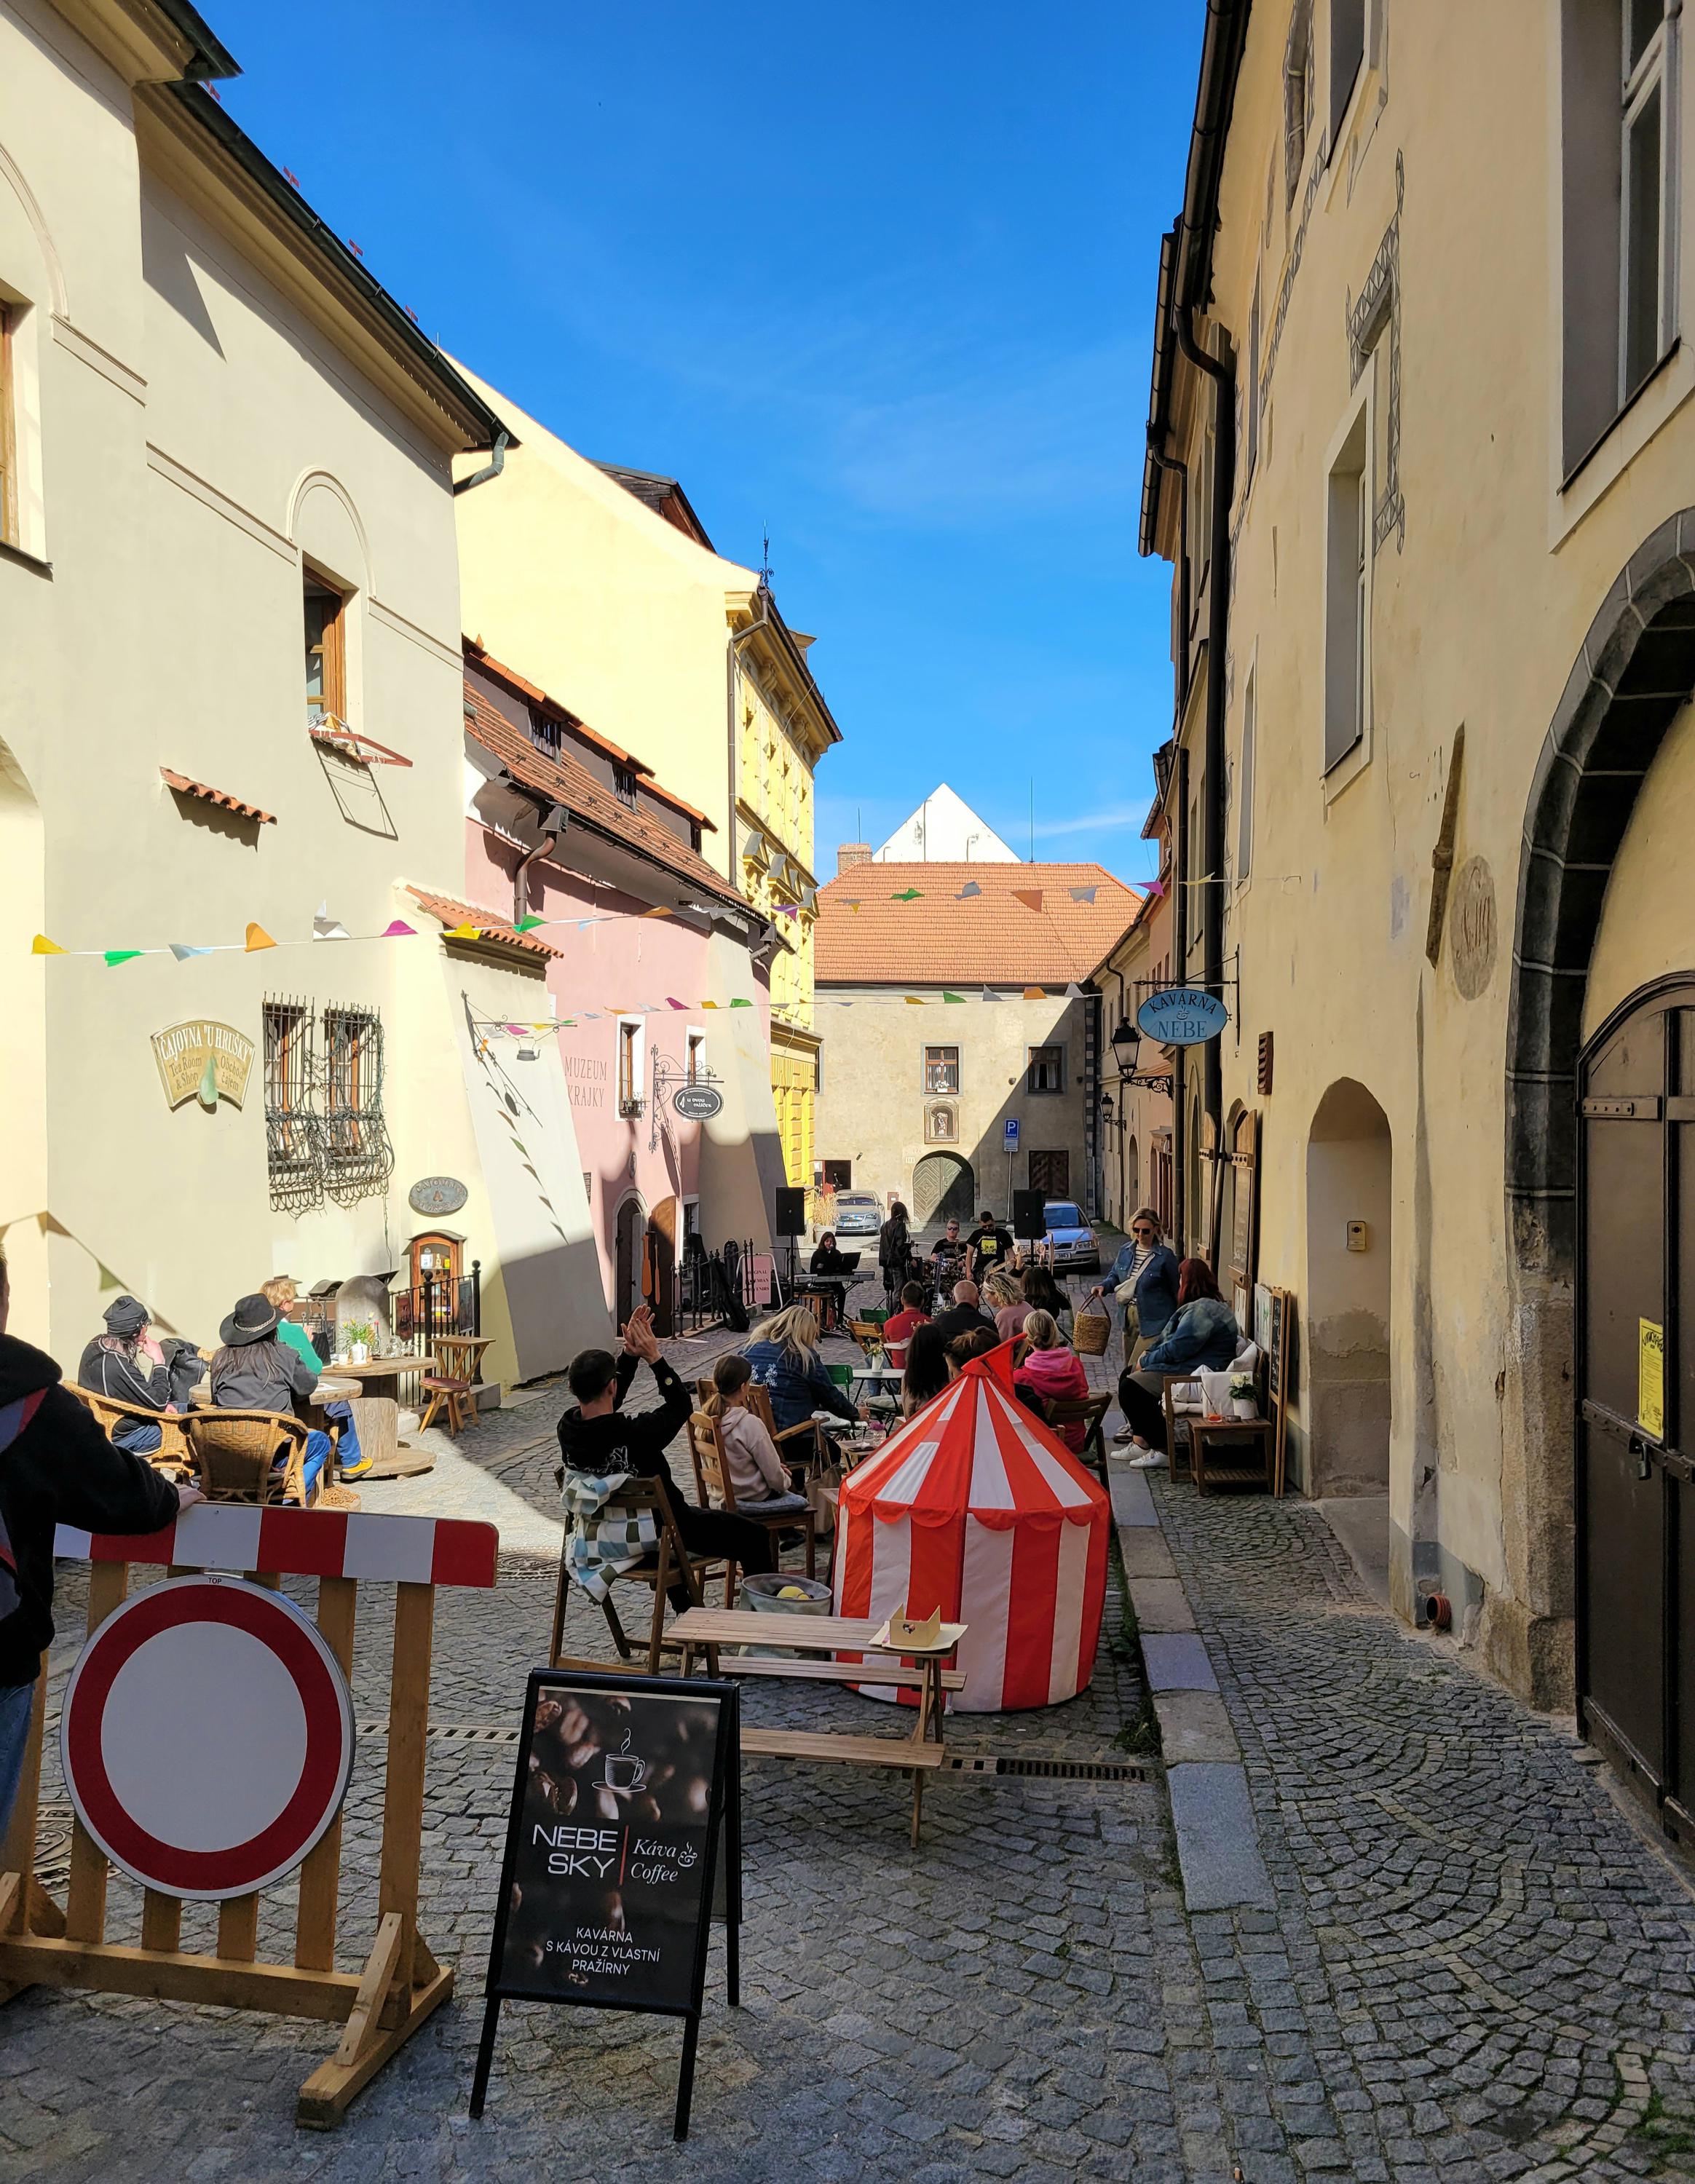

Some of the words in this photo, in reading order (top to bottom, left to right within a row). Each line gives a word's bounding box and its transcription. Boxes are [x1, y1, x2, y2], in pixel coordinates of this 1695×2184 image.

[1149, 991, 1217, 1015] KAVÁRNA
[1158, 1021, 1207, 1037] NEBE
[160, 1025, 202, 1061] ČAJOVNA
[215, 1027, 253, 1062] HRUŠKY"
[169, 1063, 182, 1077] Tea
[182, 1056, 202, 1071] Room
[221, 1055, 246, 1080] Obchod
[565, 1056, 607, 1080] MUZEUM
[175, 1077, 182, 1091] &
[181, 1072, 199, 1087] Shop
[221, 1072, 239, 1091] čajem
[568, 1085, 604, 1107] KRAJKY
[1008, 1122, 1016, 1133] P
[532, 1824, 618, 1852] NEBE
[633, 1838, 676, 1858] Káva
[548, 1853, 615, 1878] SKY
[631, 1862, 678, 1884] Coffee
[576, 1927, 633, 1943] KAVÁRNA
[546, 1940, 553, 1951] S
[556, 1939, 598, 1956] KÁVOU
[601, 1946, 609, 1957] Z
[612, 1947, 660, 1963] VLASTNÍ
[572, 1958, 630, 1975] PRAŽÍRNY
